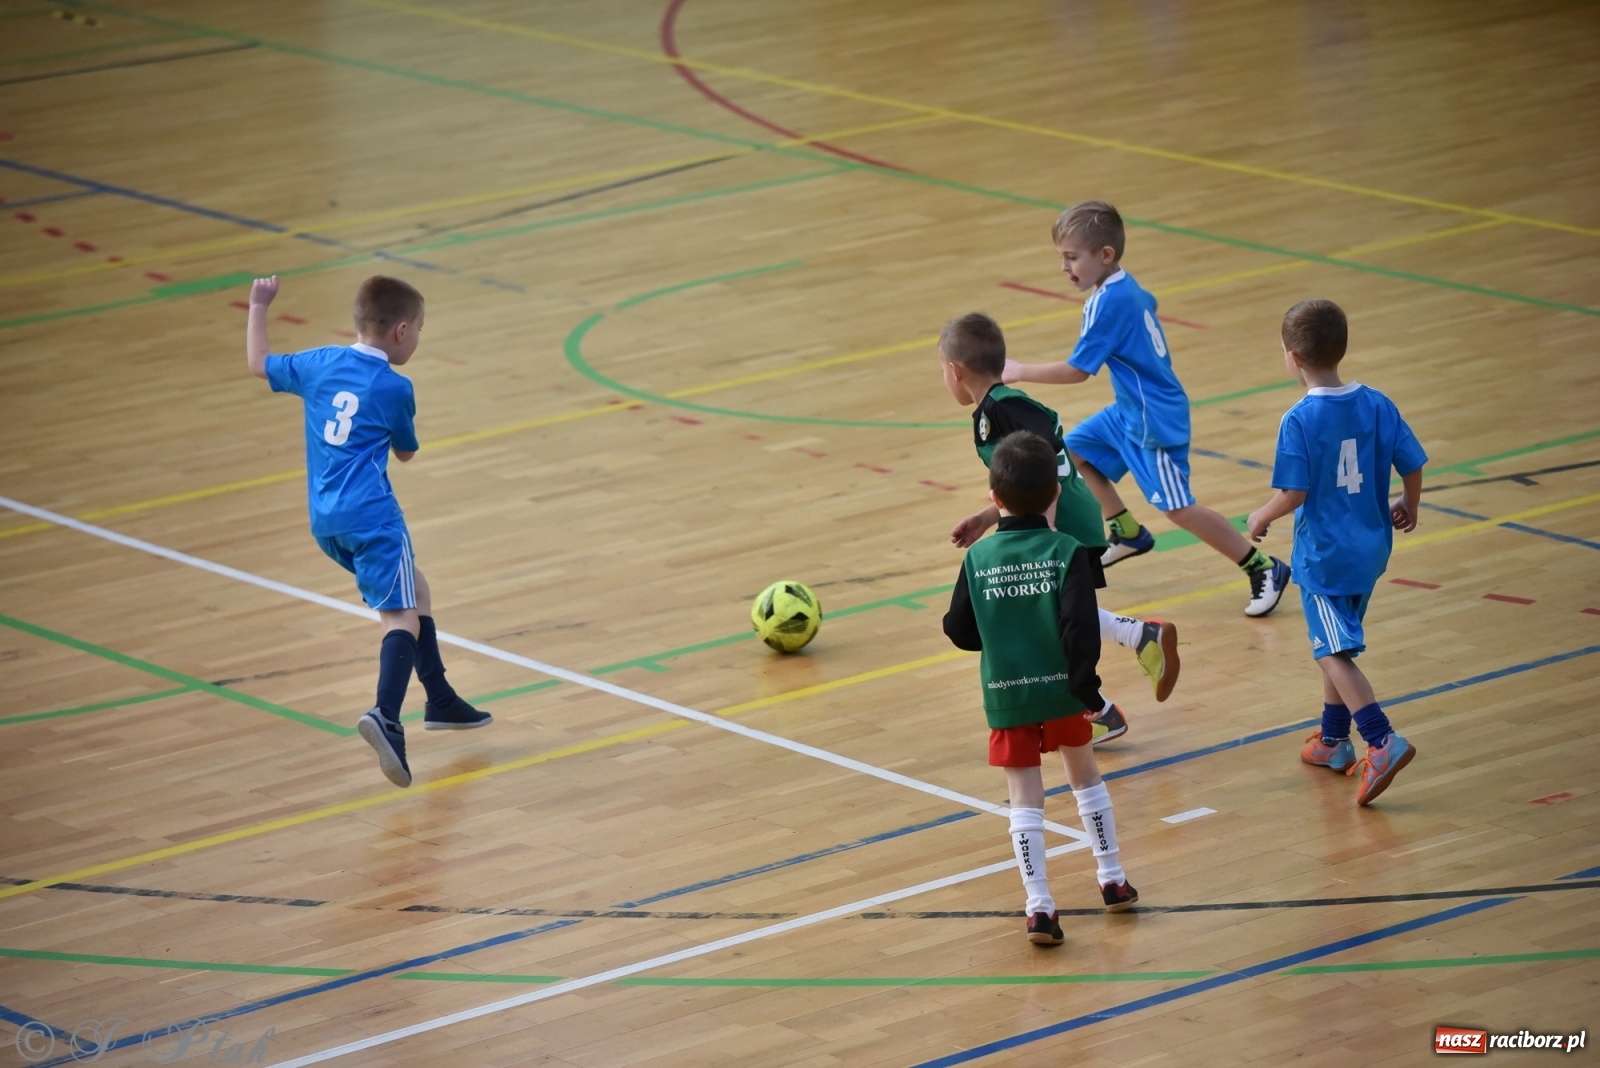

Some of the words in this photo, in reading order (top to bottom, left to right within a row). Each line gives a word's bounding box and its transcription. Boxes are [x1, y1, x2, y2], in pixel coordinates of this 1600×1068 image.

[323, 390, 359, 446] 3
[1336, 437, 1364, 494] 4
[974, 564, 1020, 578] AKADEMIA
[982, 578, 1060, 601] TWORKÓW
